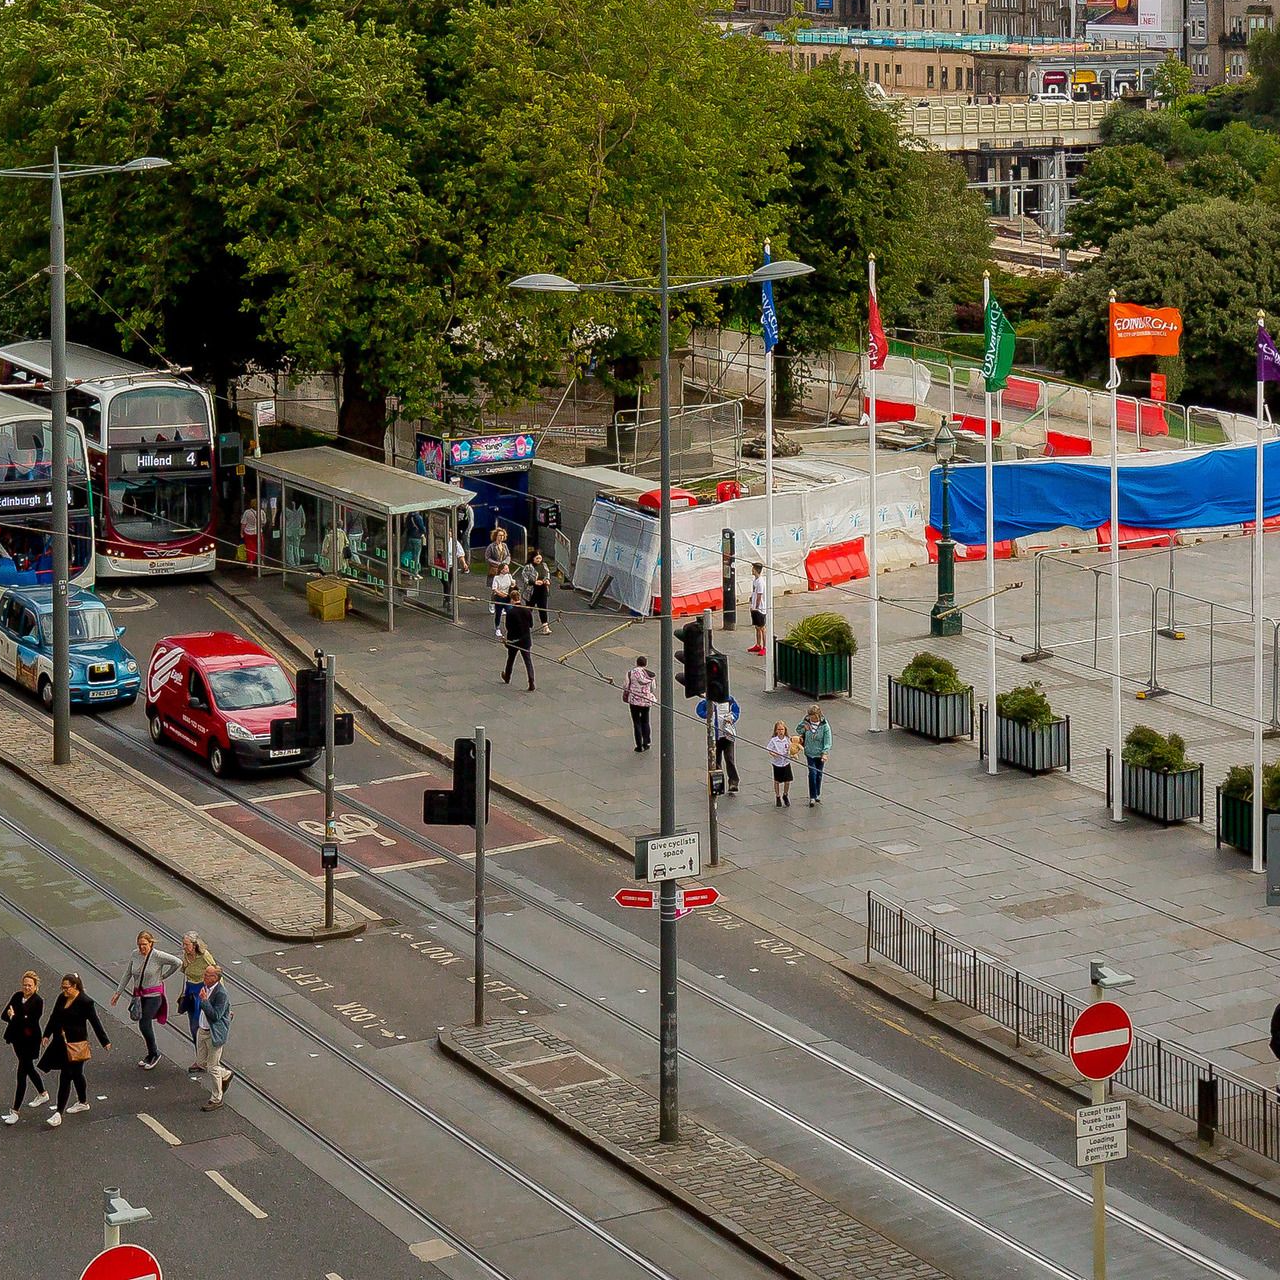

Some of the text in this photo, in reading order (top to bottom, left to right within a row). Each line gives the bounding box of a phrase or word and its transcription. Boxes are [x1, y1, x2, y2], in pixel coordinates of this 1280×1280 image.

[137, 452, 196, 466] Hillend 4
[170, 668, 184, 683] Eagle
[650, 838, 696, 851] Give cyclists
[663, 849, 684, 858] space
[410, 940, 464, 967] LOOK
[276, 966, 388, 1030] LOOK LEFT
[1078, 1109, 1102, 1119] Except
[1105, 1112, 1121, 1120] taxis
[1094, 1122, 1115, 1132] cycles
[1086, 1142, 1118, 1154] permitted
[1089, 1135, 1114, 1148] Loading
